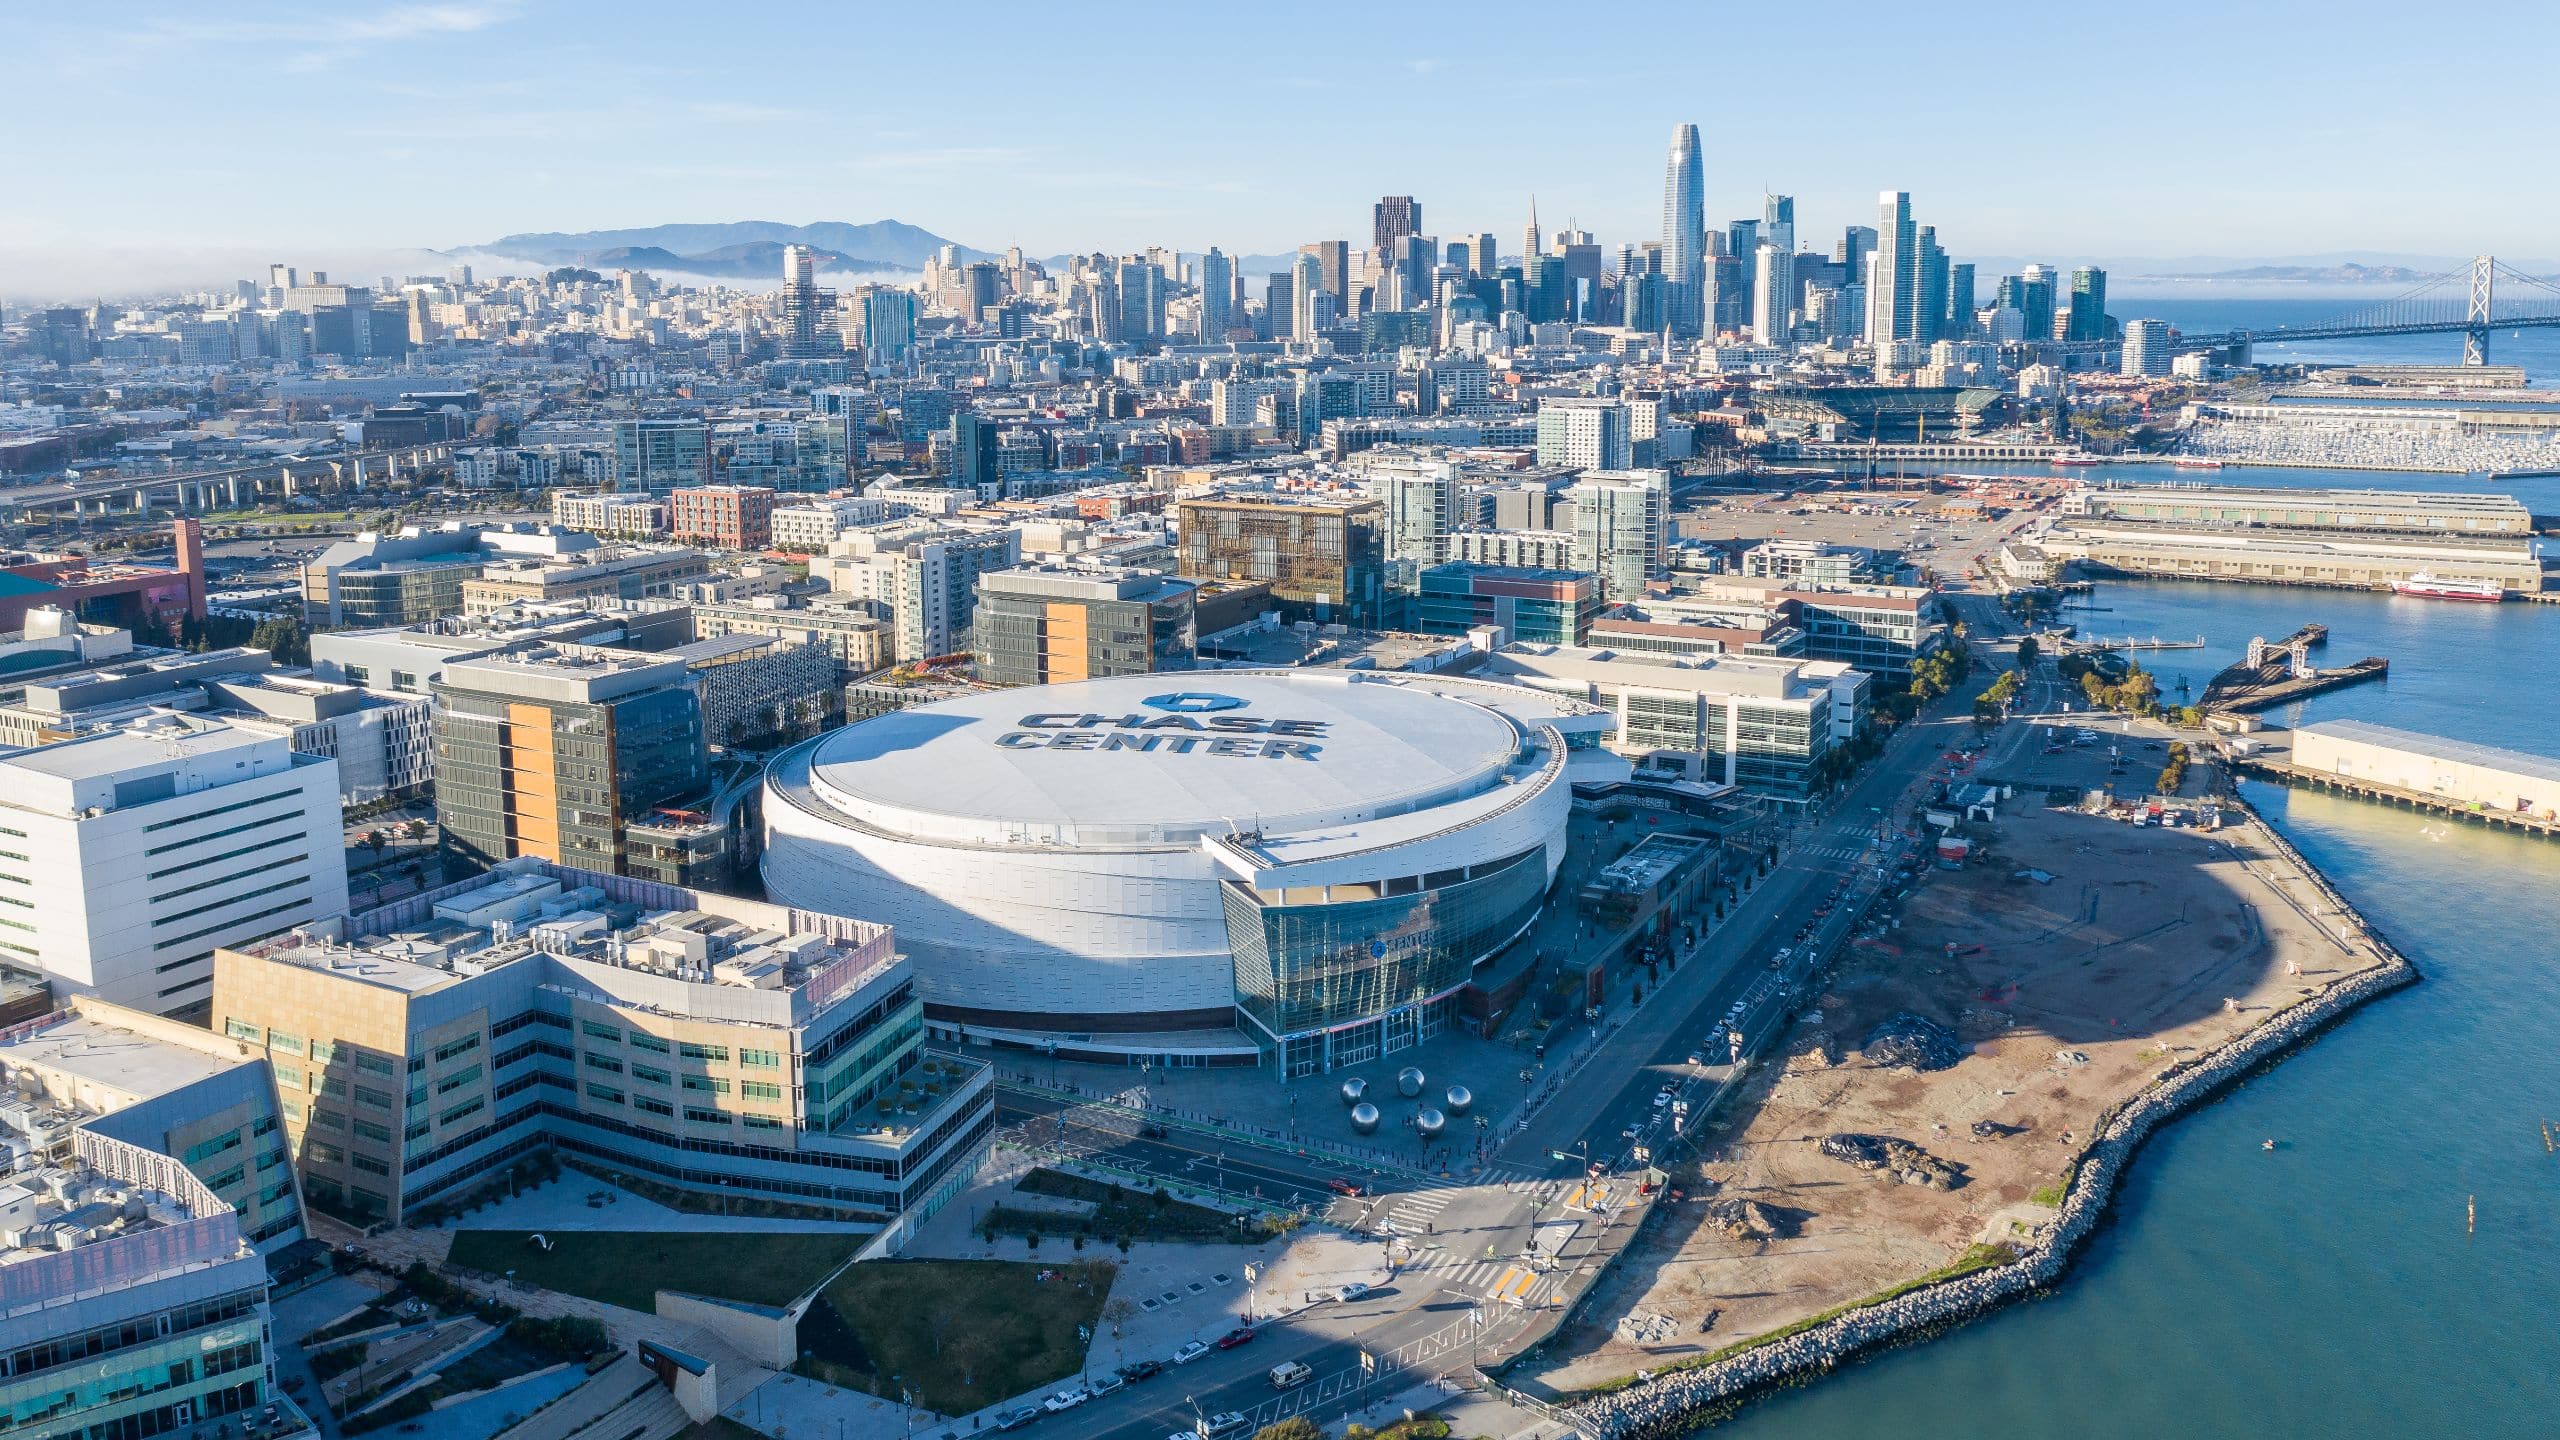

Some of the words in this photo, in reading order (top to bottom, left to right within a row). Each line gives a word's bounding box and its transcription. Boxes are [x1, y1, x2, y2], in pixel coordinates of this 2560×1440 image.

[1017, 713, 1327, 737] CHASE
[993, 731, 1317, 760] CENTER
[1314, 947, 1368, 969] CHASE
[1388, 930, 1436, 951] CENTER
